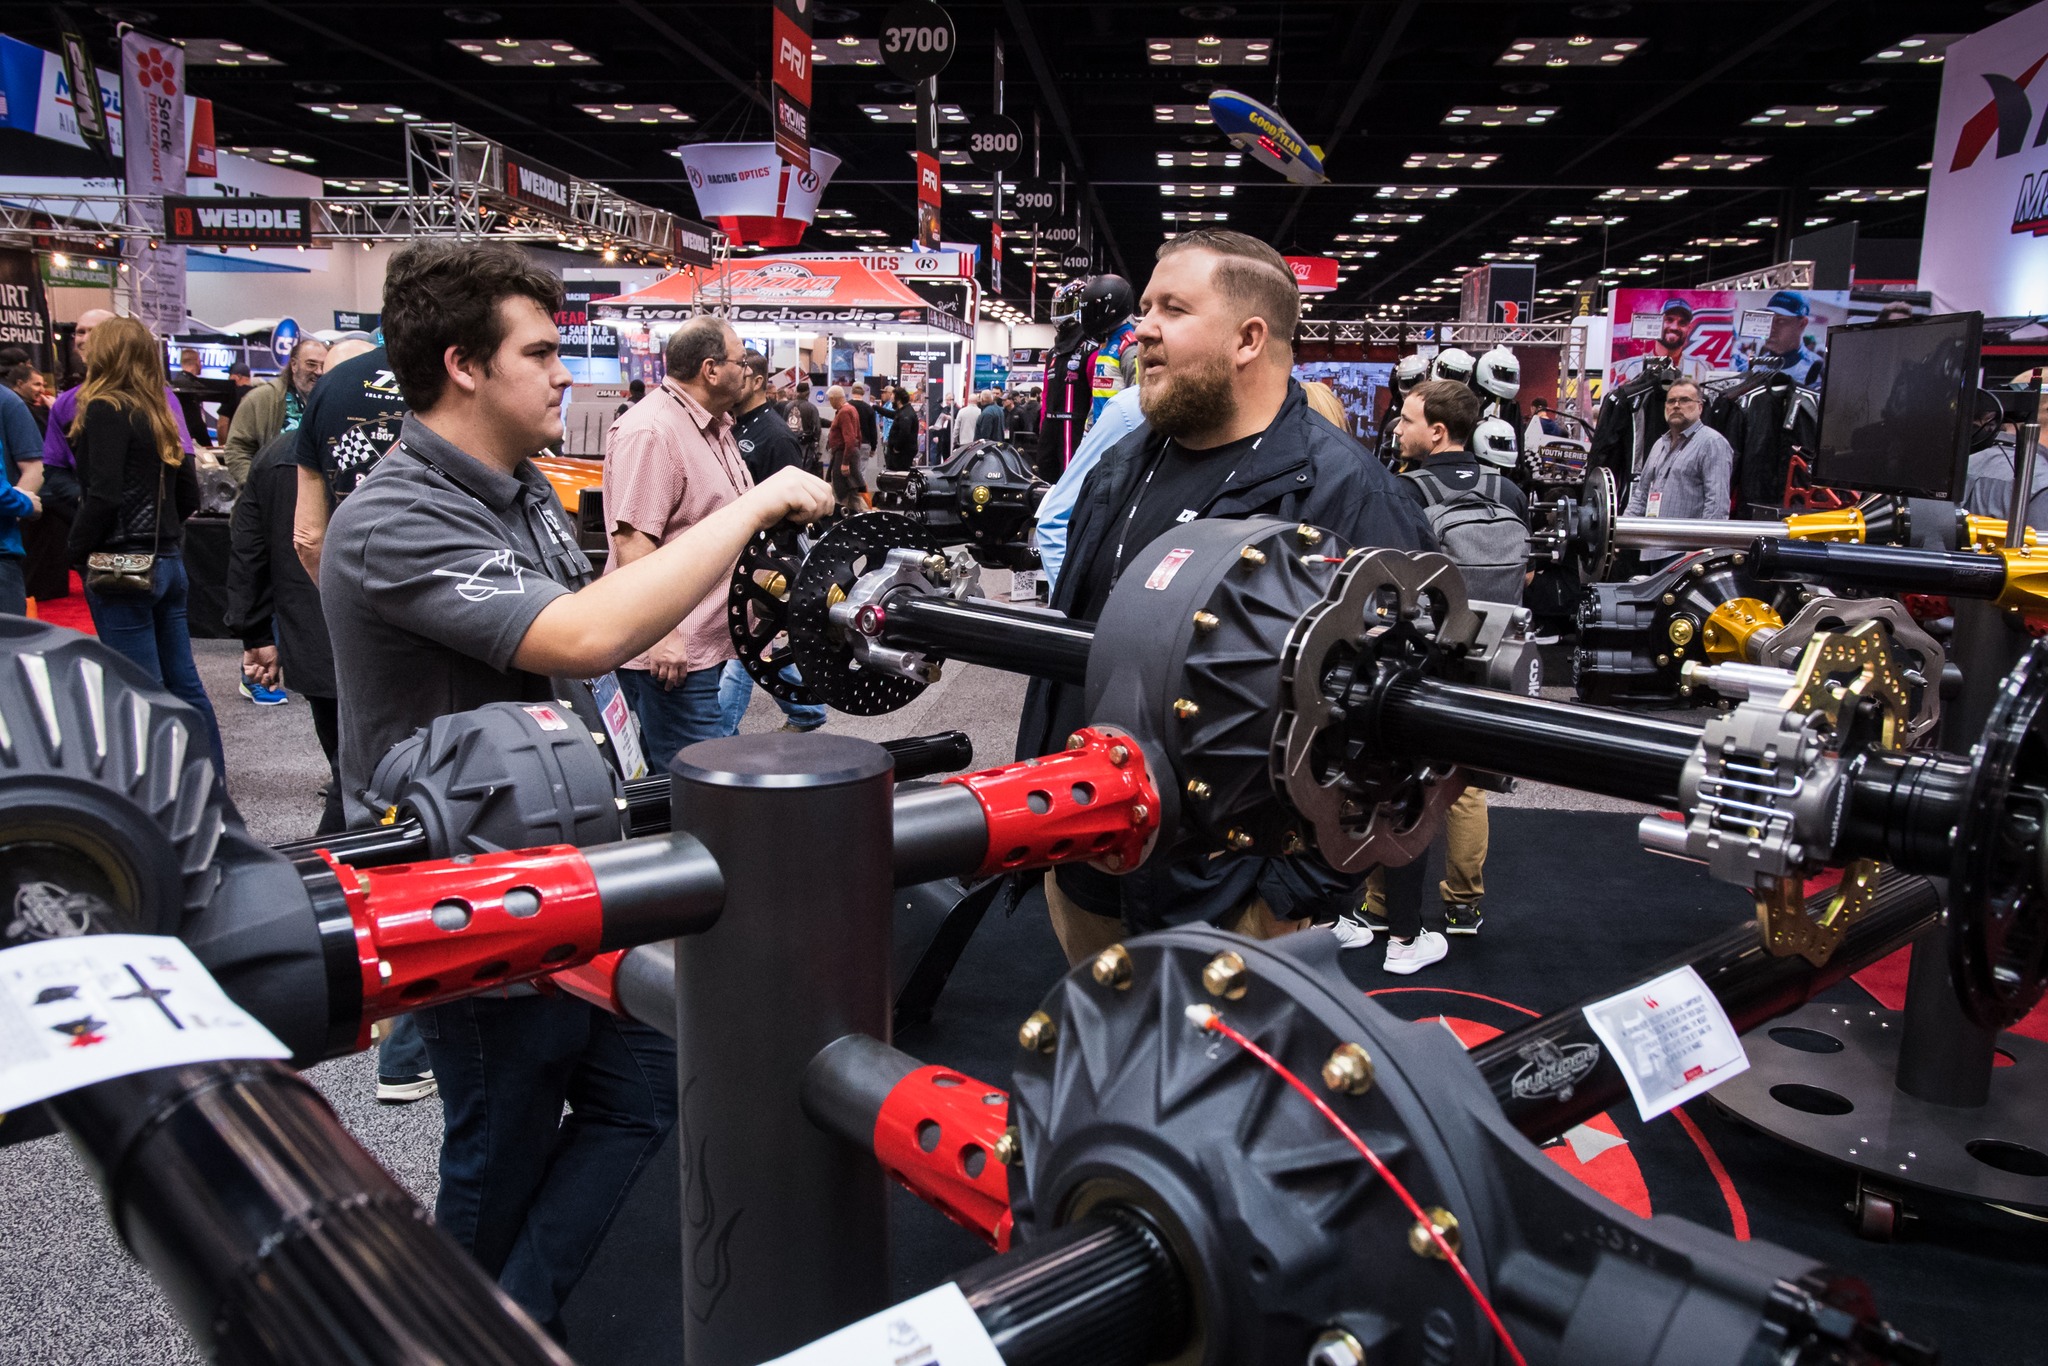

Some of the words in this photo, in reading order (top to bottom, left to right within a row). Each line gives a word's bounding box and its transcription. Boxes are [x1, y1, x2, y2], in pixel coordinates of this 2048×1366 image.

[885, 27, 949, 53] 3700
[780, 37, 806, 80] PRI
[158, 96, 173, 153] Serck
[784, 103, 806, 134] ROWE
[149, 92, 164, 184] Motorsport
[970, 132, 1018, 152] 3800
[707, 172, 738, 185] RACING
[738, 167, 770, 181] OPTICS
[922, 168, 938, 192] PRI
[518, 166, 568, 206] WEDDLE
[1016, 193, 1053, 208] 3900
[197, 208, 301, 229] WEDDLE
[681, 229, 710, 255] WEDDLE
[1045, 228, 1077, 241] 4000
[1063, 257, 1089, 268] 4100
[0, 284, 29, 308] IRT
[0, 310, 34, 327] UNES
[34, 312, 44, 328] &
[712, 306, 895, 321] Merchandise
[0, 327, 45, 344] SPHALT
[558, 326, 567, 334] OF
[601, 326, 609, 335] &
[559, 335, 616, 346] ERFORMANCE
[370, 432, 395, 441] 1907
[1541, 448, 1562, 458] YOUTH
[1563, 450, 1588, 461] SERIES
